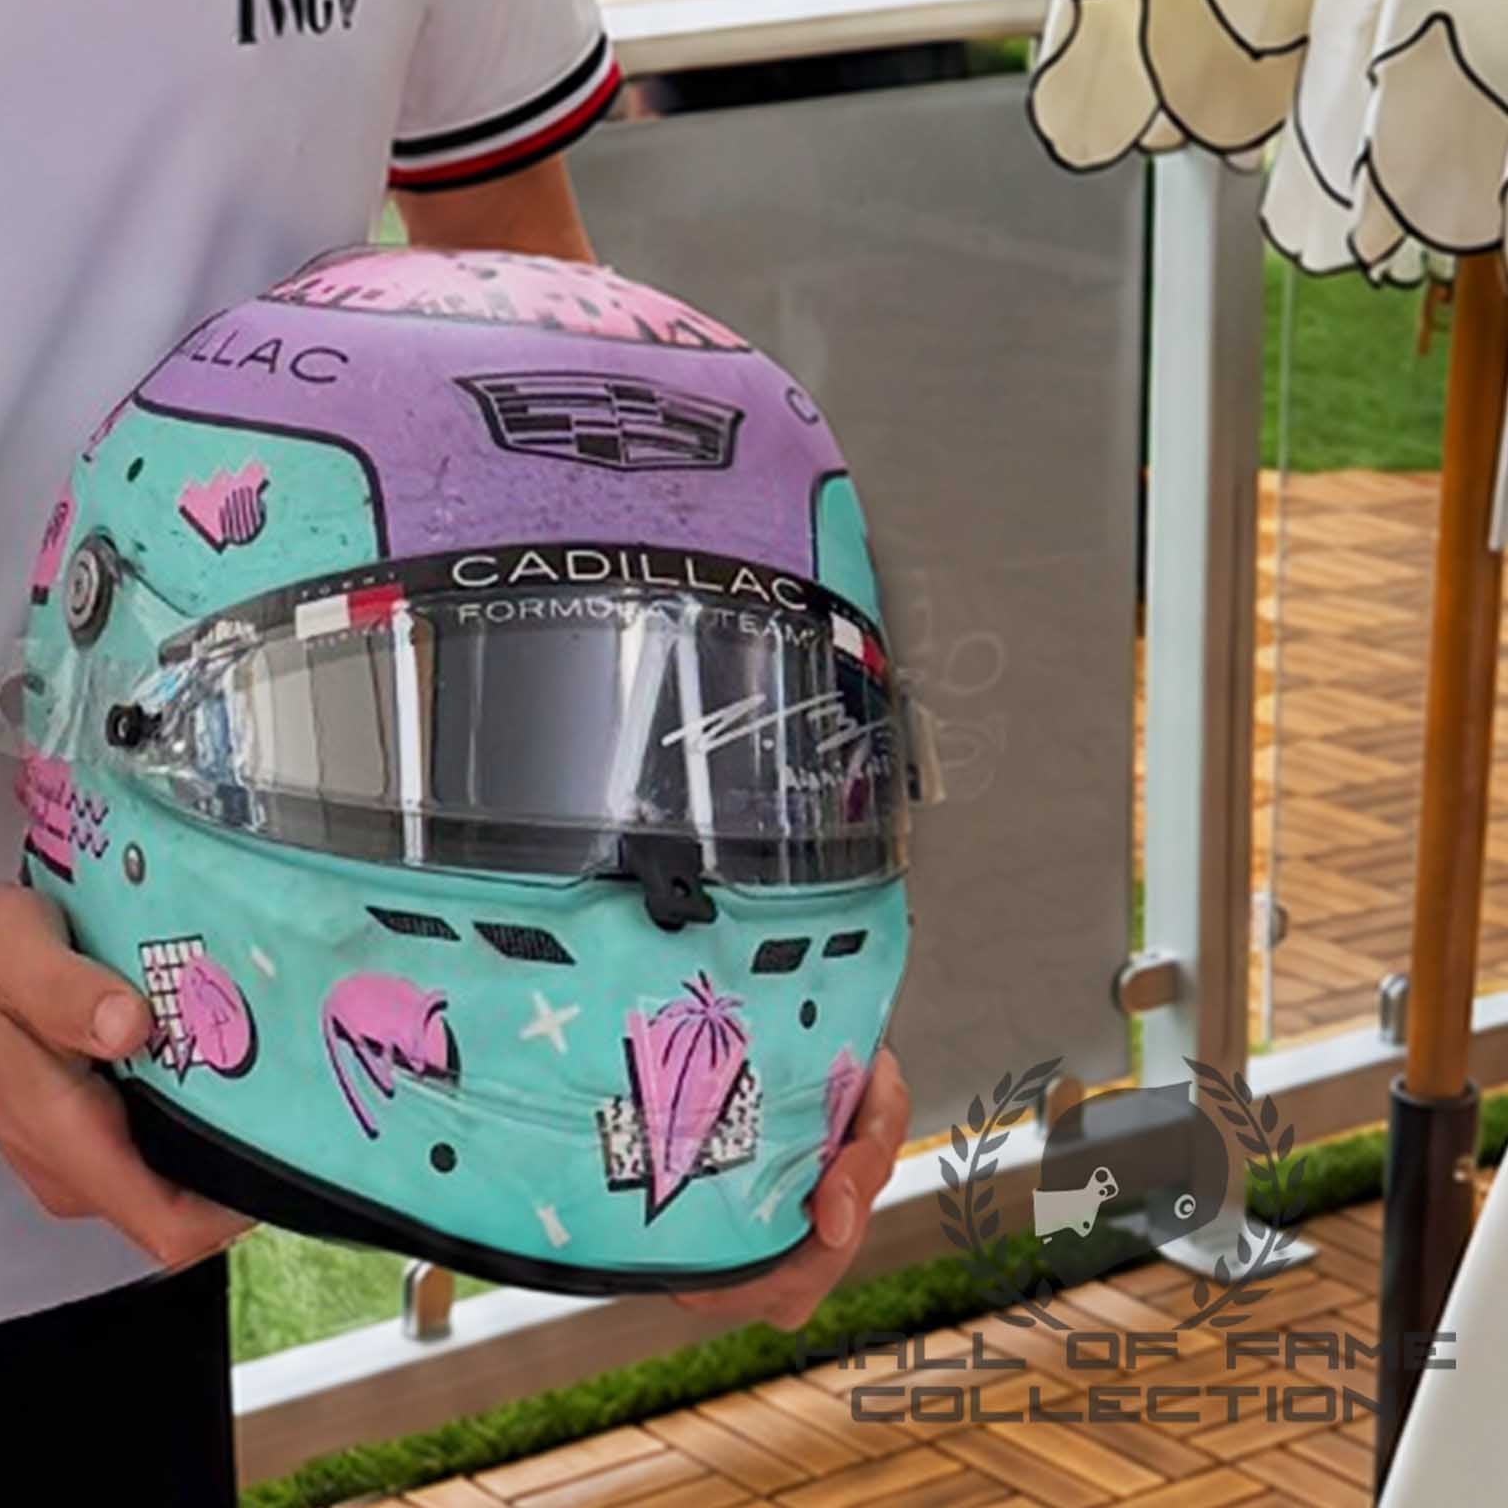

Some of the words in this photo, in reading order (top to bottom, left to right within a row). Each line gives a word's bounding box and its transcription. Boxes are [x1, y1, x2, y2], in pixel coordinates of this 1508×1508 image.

[190, 328, 350, 384] LLAC
[451, 549, 808, 611] CADILLAC
[457, 595, 672, 626] FORMUA
